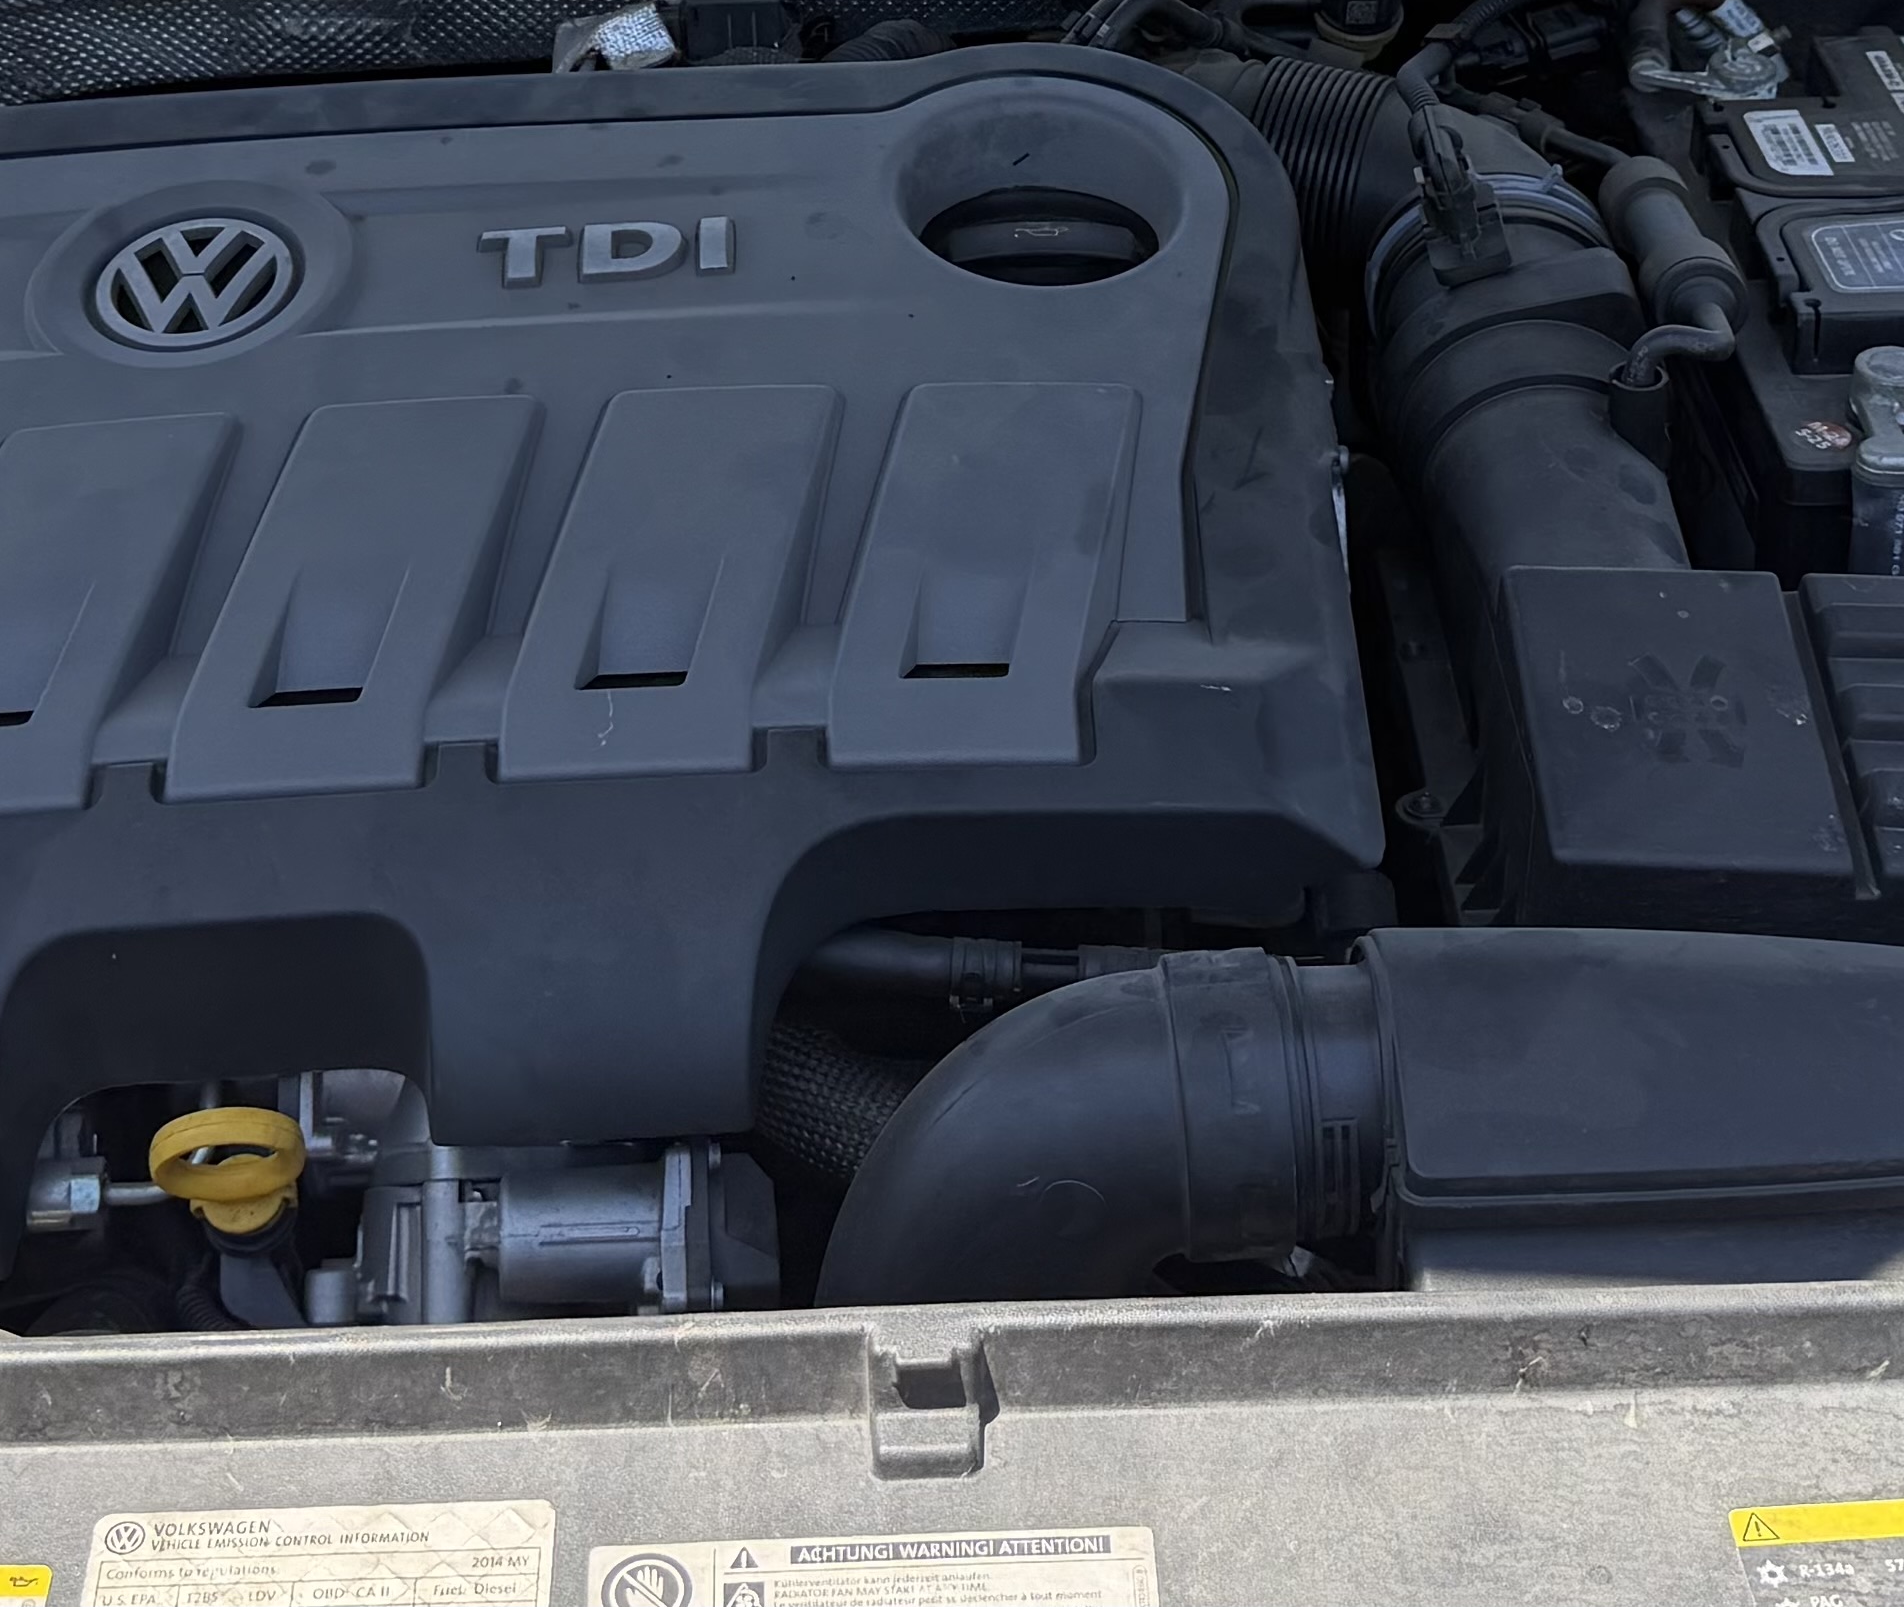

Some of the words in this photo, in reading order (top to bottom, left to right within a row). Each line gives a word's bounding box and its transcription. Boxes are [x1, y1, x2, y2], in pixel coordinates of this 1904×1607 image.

[477, 215, 737, 290] TDI
[154, 1521, 271, 1537] VOLKSWAGEN
[151, 1538, 200, 1552] VEHICLE
[207, 1536, 269, 1548] EMISSION
[275, 1534, 333, 1546] CONTROL
[340, 1531, 430, 1545] INFORMATION
[471, 1556, 503, 1569] 2014
[508, 1555, 530, 1567] MY
[107, 1566, 175, 1580] Conforms
[179, 1567, 193, 1577] to
